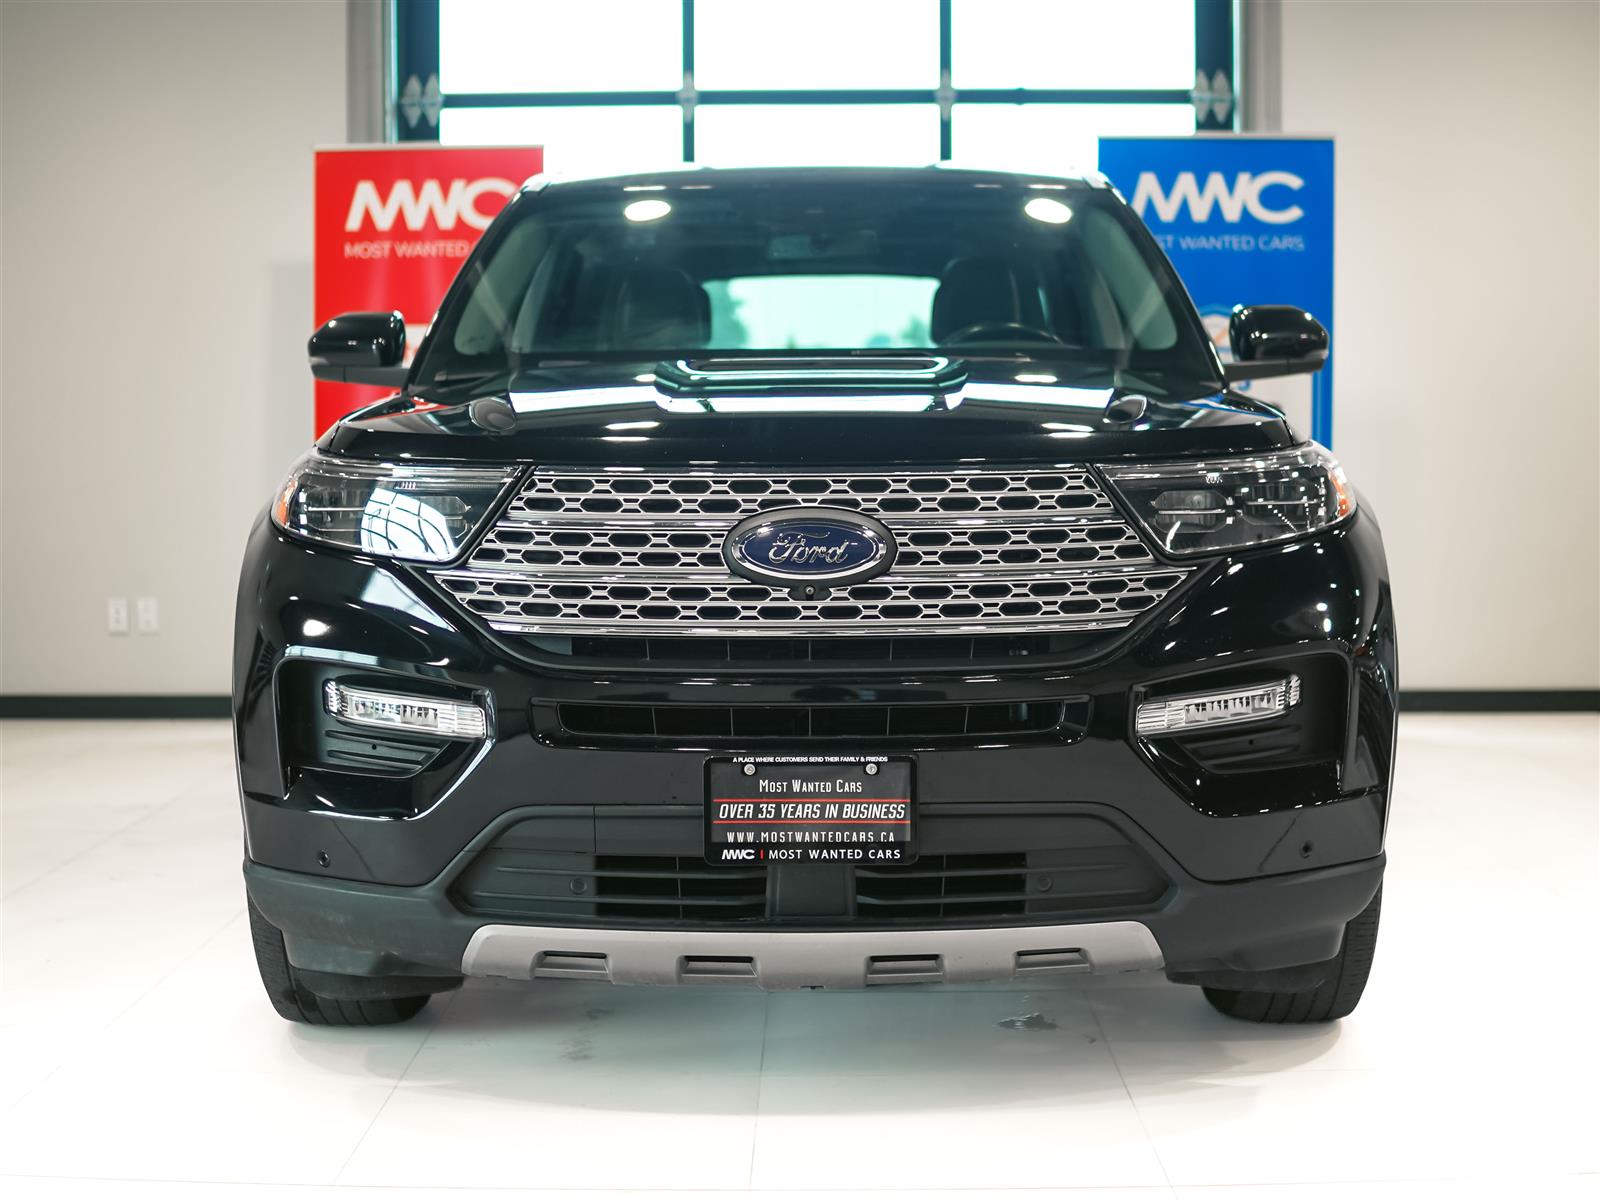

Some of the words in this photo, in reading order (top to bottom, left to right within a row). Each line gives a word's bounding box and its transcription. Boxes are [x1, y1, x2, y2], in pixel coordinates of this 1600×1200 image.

[1133, 170, 1305, 224] MWC
[344, 241, 391, 259] MOST
[395, 240, 470, 258] WANTED
[1179, 235, 1255, 250] WANTED
[1258, 235, 1304, 251] CARS
[768, 531, 849, 564] Ford
[719, 803, 754, 819] OVER
[758, 803, 776, 819] 35
[780, 803, 821, 819] YEARS
[824, 803, 839, 819] IN
[842, 803, 906, 819] BUSINESS
[721, 848, 755, 860] MWC
[768, 849, 803, 860] MOST
[808, 849, 863, 859] WANTED
[868, 849, 901, 859] CARS
